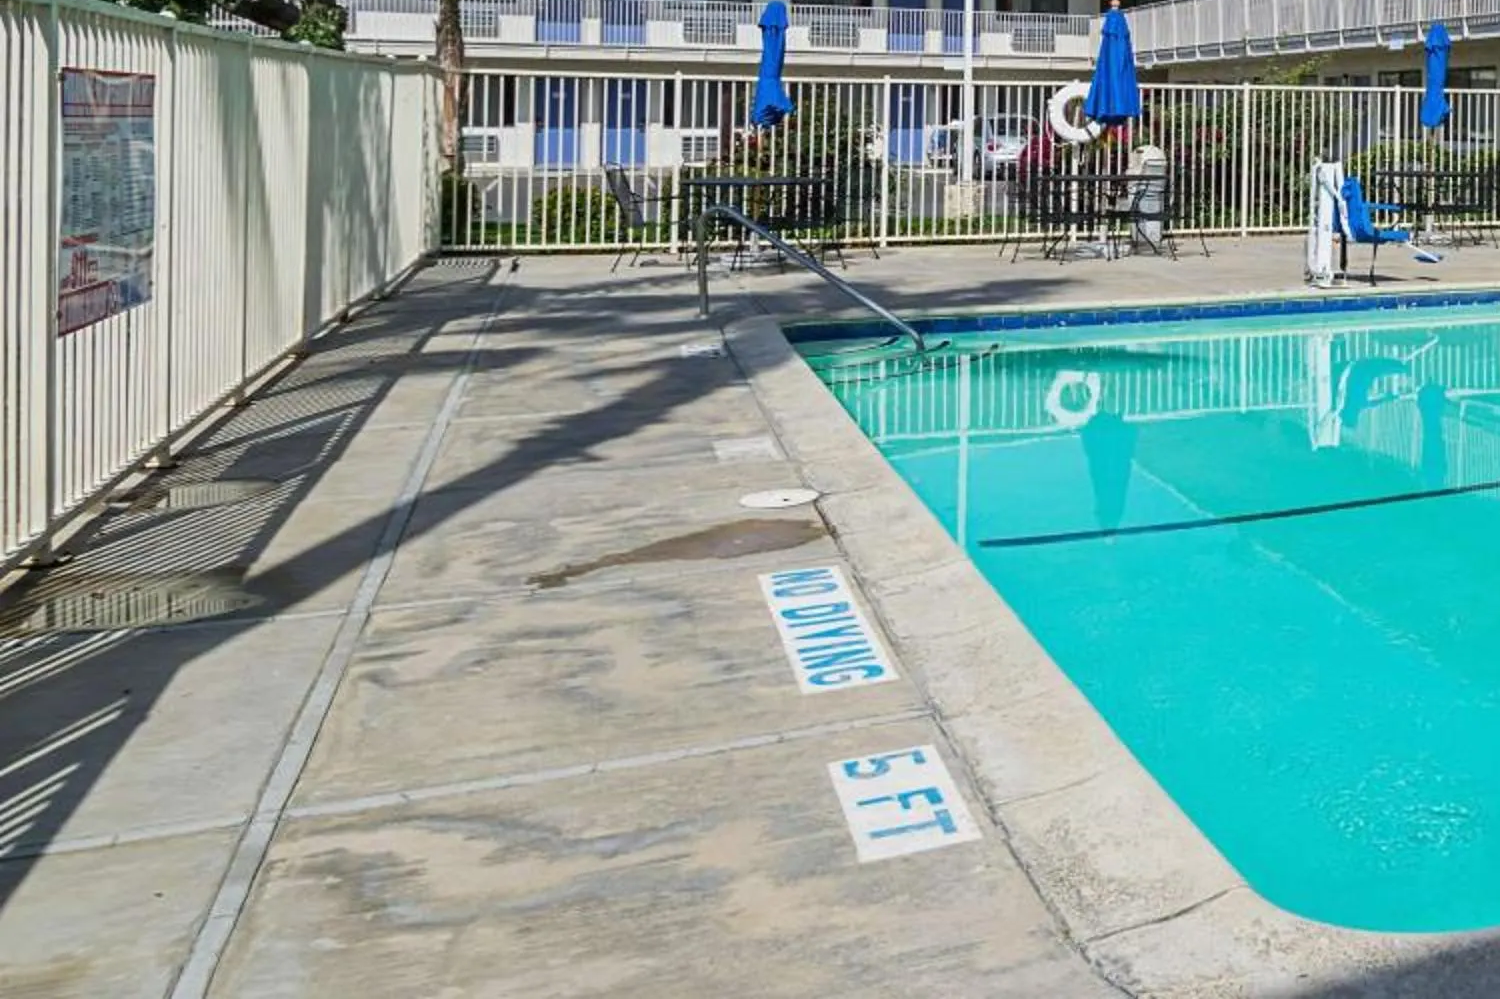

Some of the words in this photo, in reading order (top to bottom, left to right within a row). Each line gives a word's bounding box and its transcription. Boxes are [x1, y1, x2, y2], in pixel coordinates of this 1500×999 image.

[771, 567, 839, 598] NO
[780, 601, 885, 686] DIVING
[843, 749, 927, 779] 5
[856, 786, 958, 839] FT
